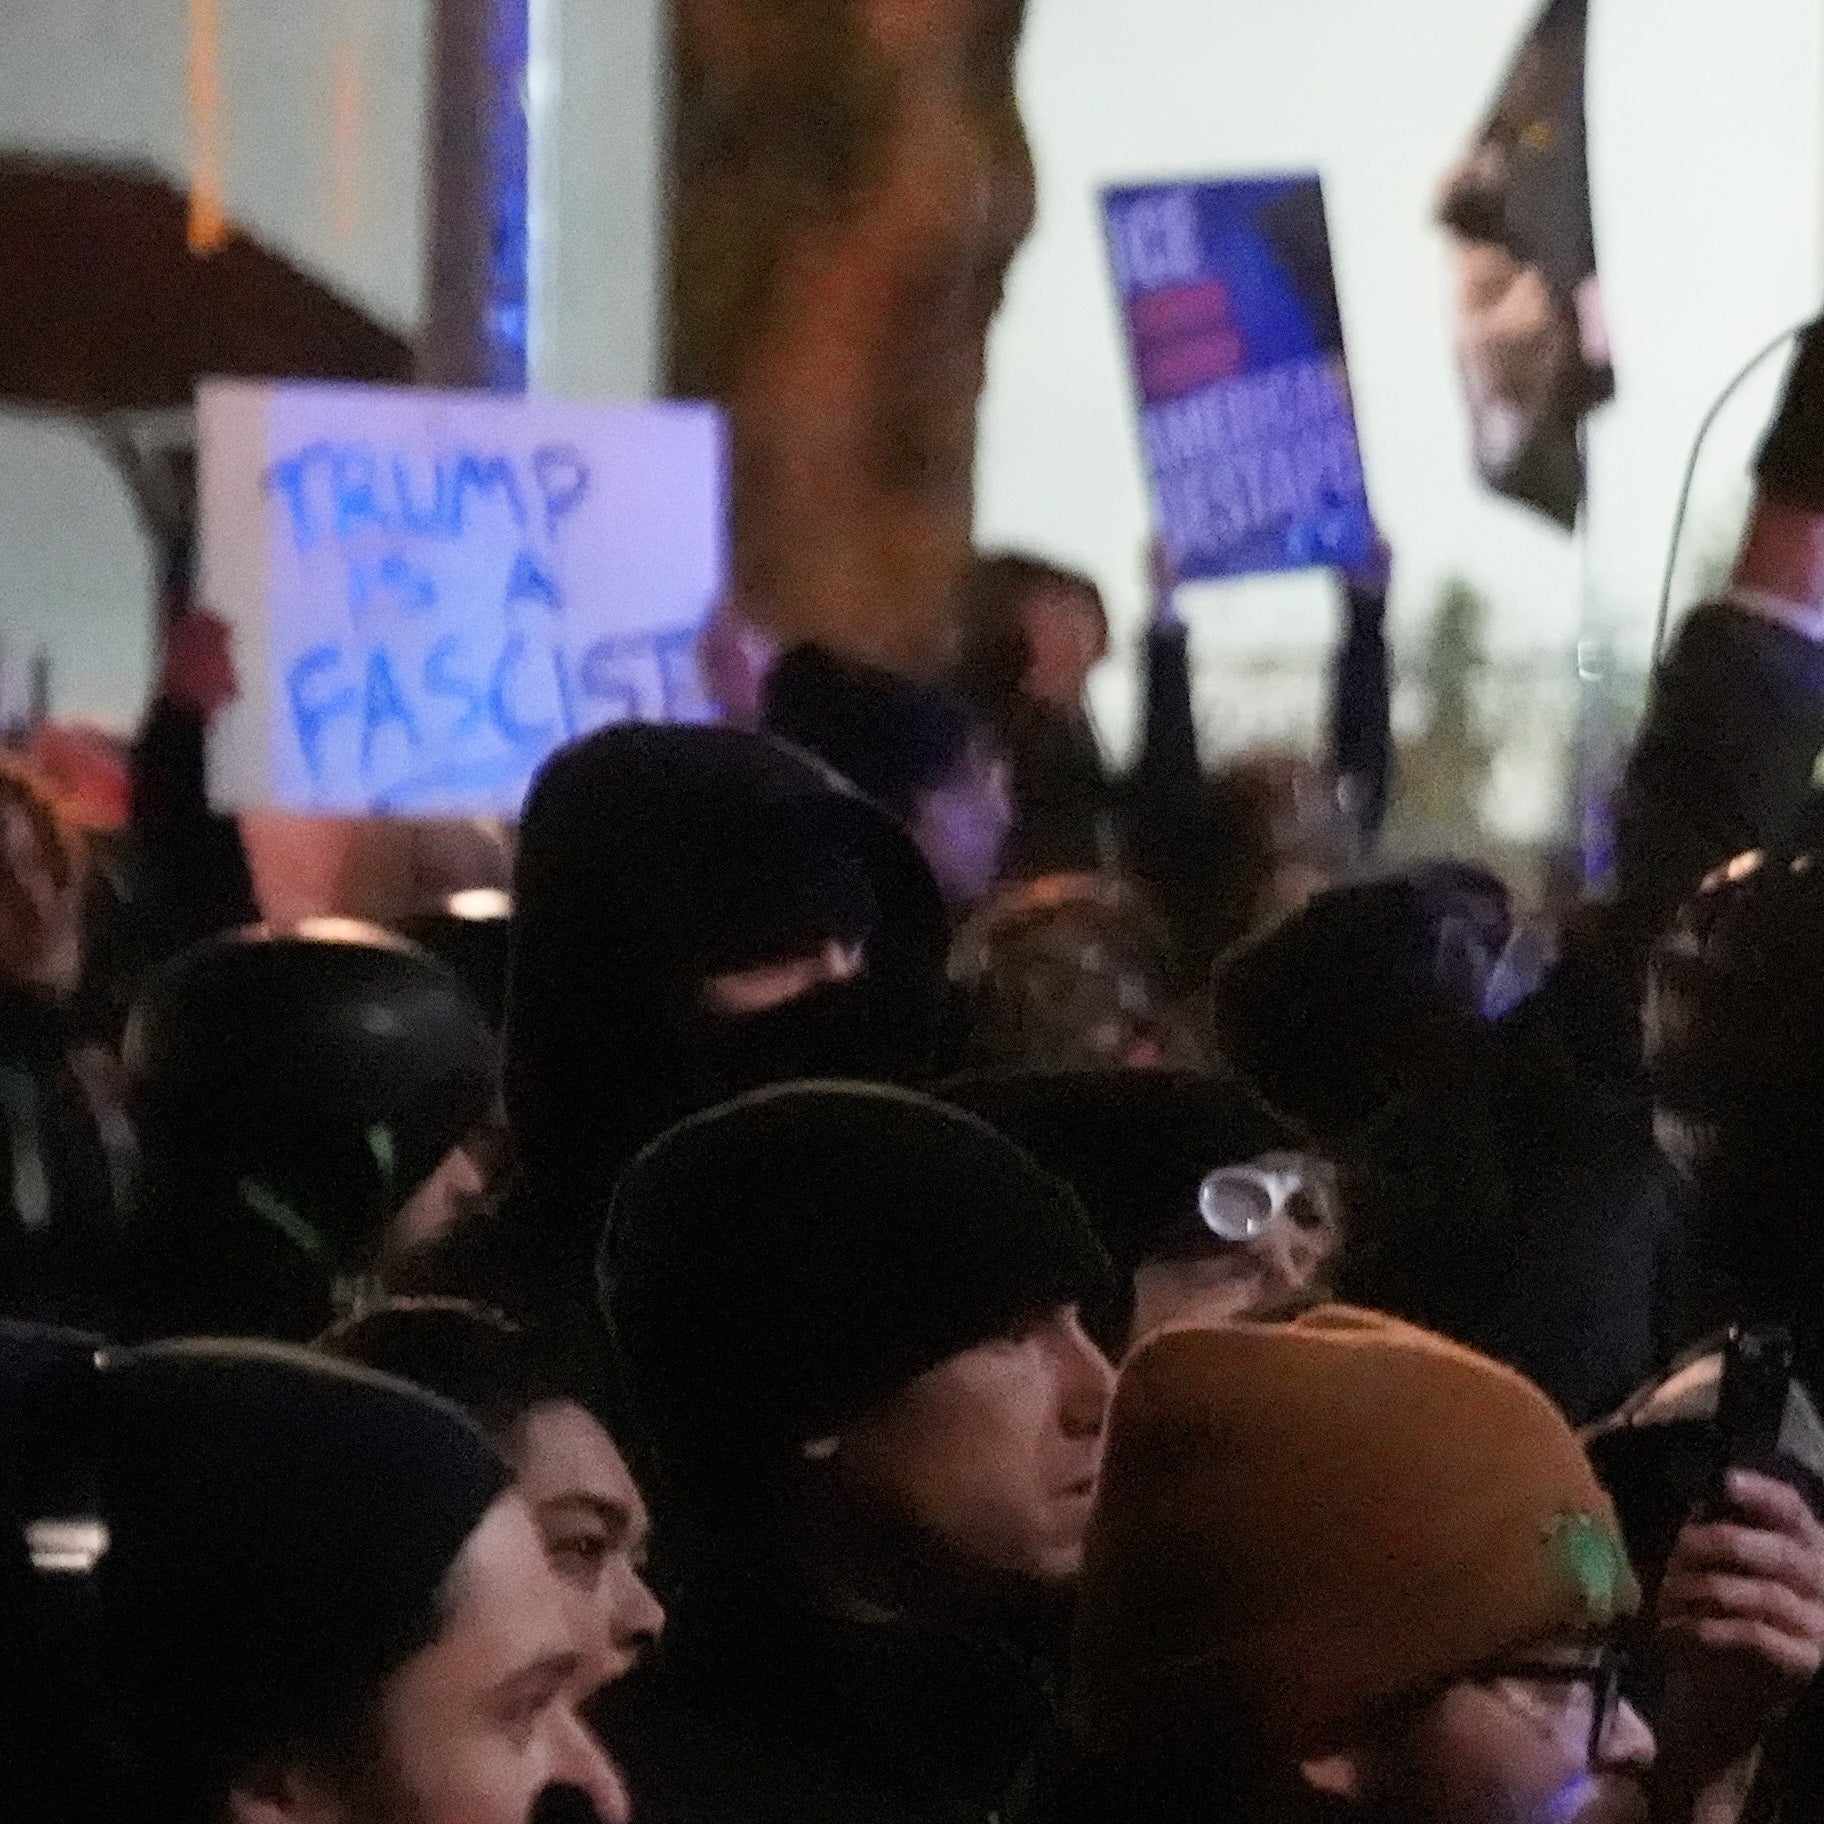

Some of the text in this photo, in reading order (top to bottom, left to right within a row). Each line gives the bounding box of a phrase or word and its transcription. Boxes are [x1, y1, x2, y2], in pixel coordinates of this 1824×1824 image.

[264, 440, 590, 550] TRUMP
[345, 550, 562, 635] IS A
[286, 622, 706, 778] FASCIST
